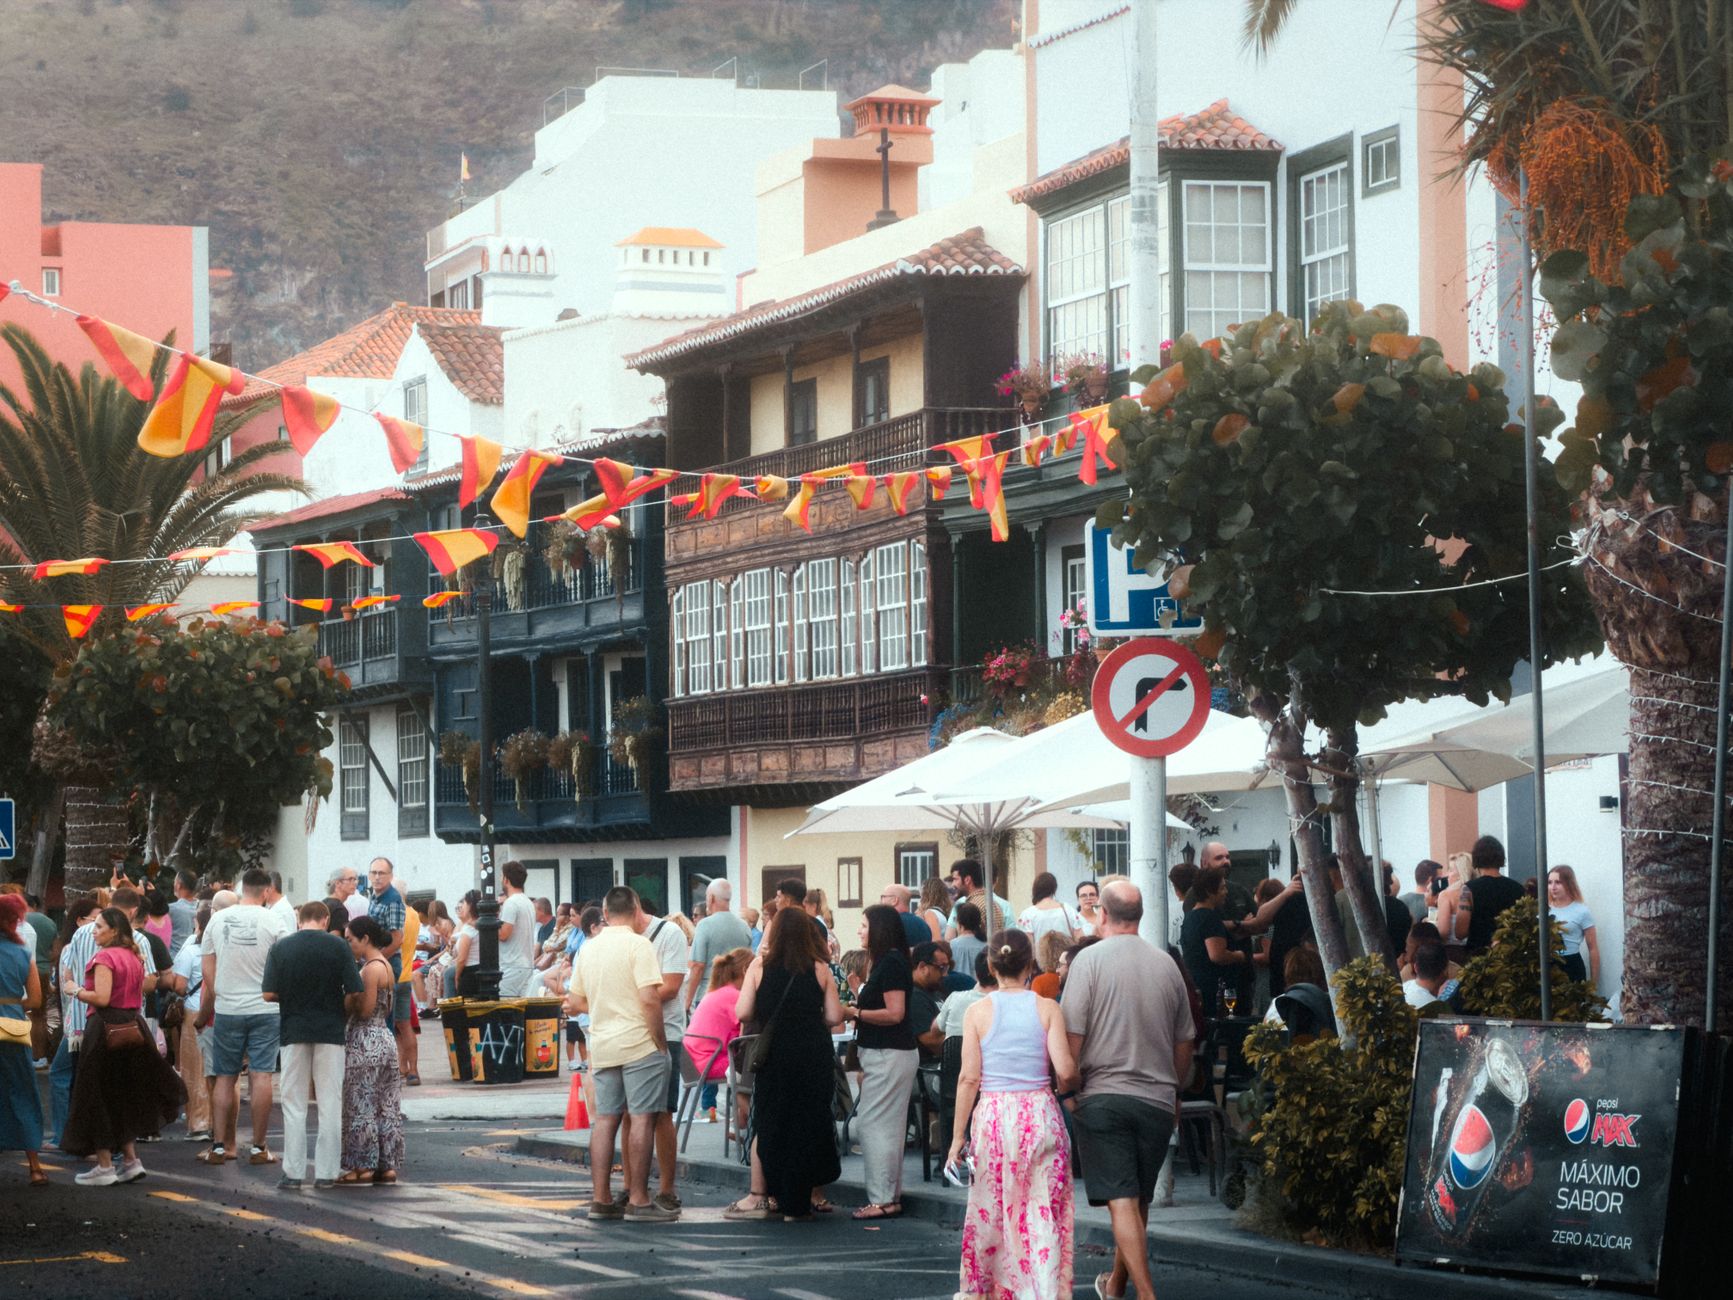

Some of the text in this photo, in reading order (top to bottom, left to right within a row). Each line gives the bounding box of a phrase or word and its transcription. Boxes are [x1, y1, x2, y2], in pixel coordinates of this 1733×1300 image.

[1596, 1097, 1619, 1110] pepsi
[1591, 1112, 1642, 1147] MAX
[1560, 1158, 1640, 1188] MÁXIMO
[1556, 1187, 1624, 1214] SABOR
[1551, 1229, 1633, 1250] ZERO AZÚCAR
